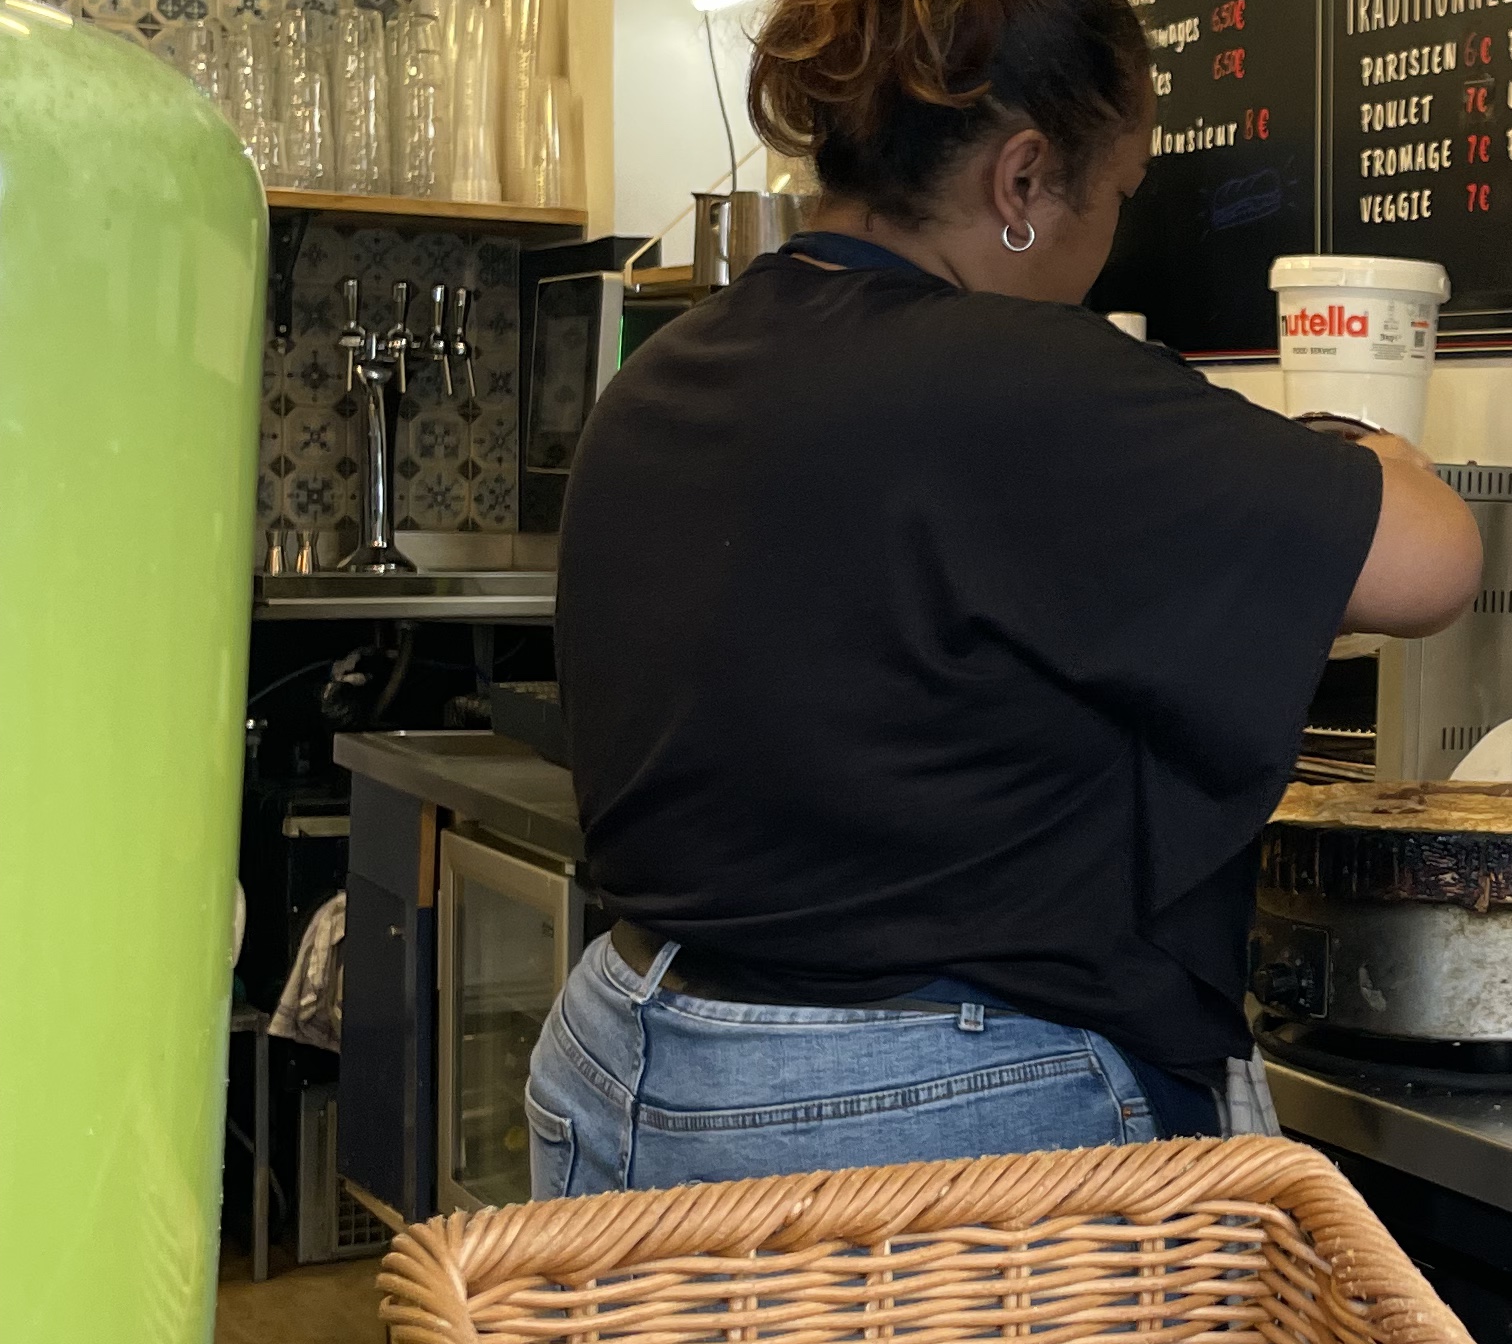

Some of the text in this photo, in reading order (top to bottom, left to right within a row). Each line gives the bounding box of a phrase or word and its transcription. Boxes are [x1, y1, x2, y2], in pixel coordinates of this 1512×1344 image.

[1360, 41, 1457, 87] PARISIEN
[1360, 95, 1434, 134] POULET
[1360, 138, 1452, 179] FROMAGE
[1360, 189, 1433, 224] VEGGIE
[1282, 305, 1369, 338] nutella
